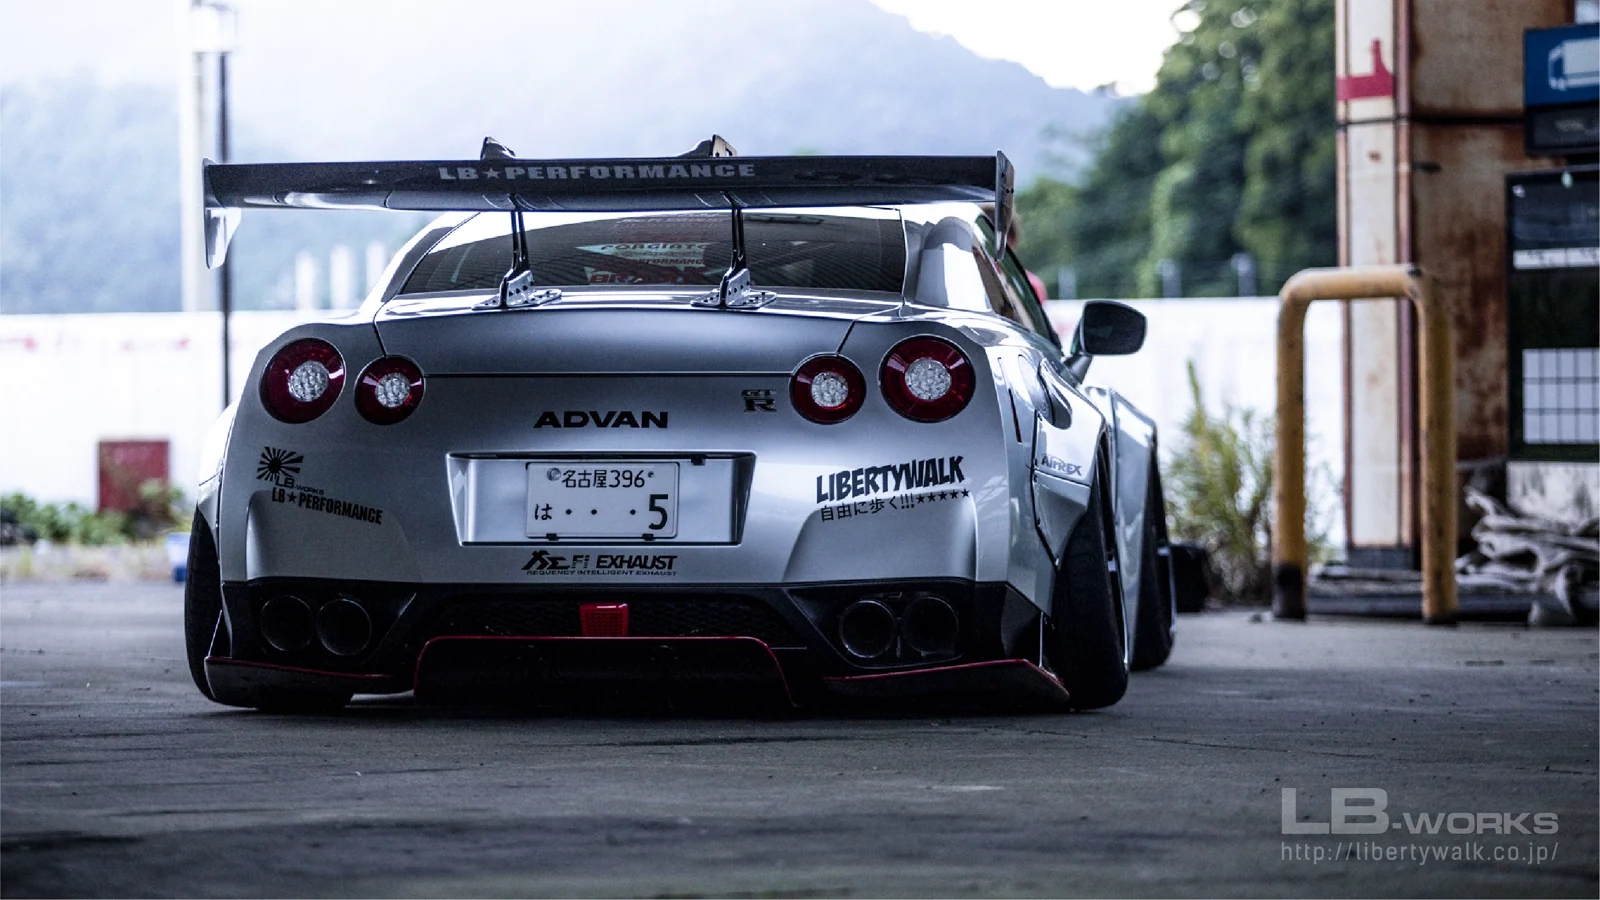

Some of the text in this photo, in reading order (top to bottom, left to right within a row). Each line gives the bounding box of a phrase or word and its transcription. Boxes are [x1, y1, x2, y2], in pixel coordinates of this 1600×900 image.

[438, 164, 755, 180] LB PERFORMANCE
[533, 411, 668, 428] ADVAN
[816, 455, 964, 504] LIBERTYWALK
[298, 492, 383, 525] PERFORMANCE
[534, 503, 553, 520] は
[596, 555, 678, 570] EXHAUST
